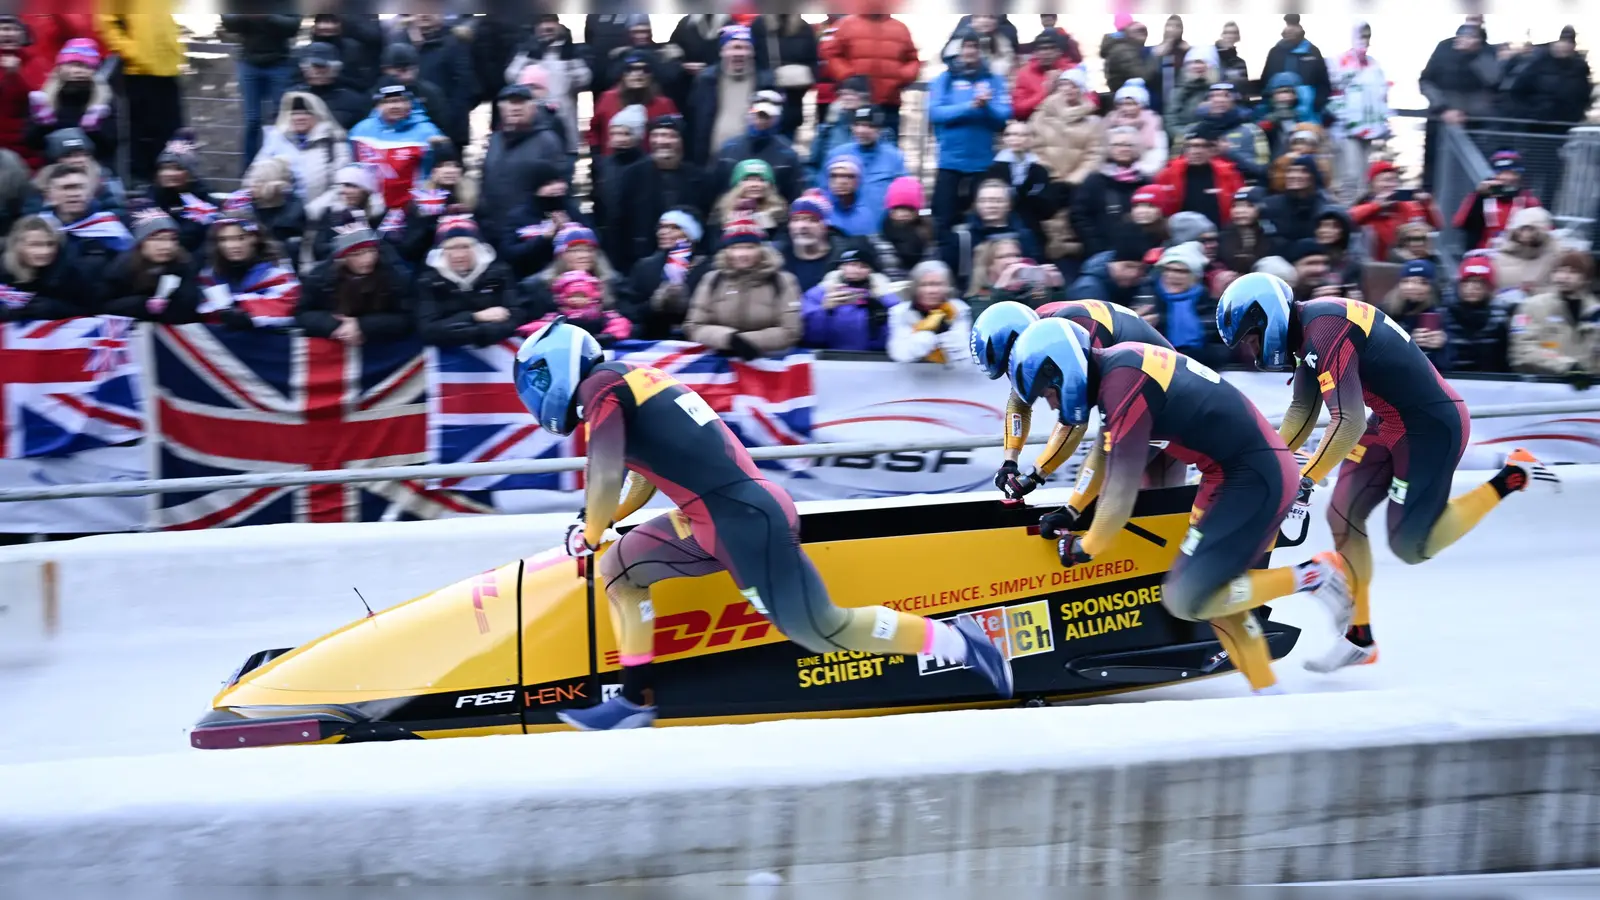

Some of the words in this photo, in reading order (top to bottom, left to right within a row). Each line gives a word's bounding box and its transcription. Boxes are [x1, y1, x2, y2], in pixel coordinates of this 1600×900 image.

[989, 574, 1046, 597] SIMPLY
[1051, 558, 1139, 585] DELIVERED.
[1060, 585, 1165, 621] SPONSORE
[1065, 610, 1143, 641] ALLIANZ
[797, 656, 821, 667] EINE
[798, 658, 885, 688] SCHIEBT
[888, 655, 904, 665] AN
[455, 690, 516, 708] FES
[524, 683, 588, 707] HENK
